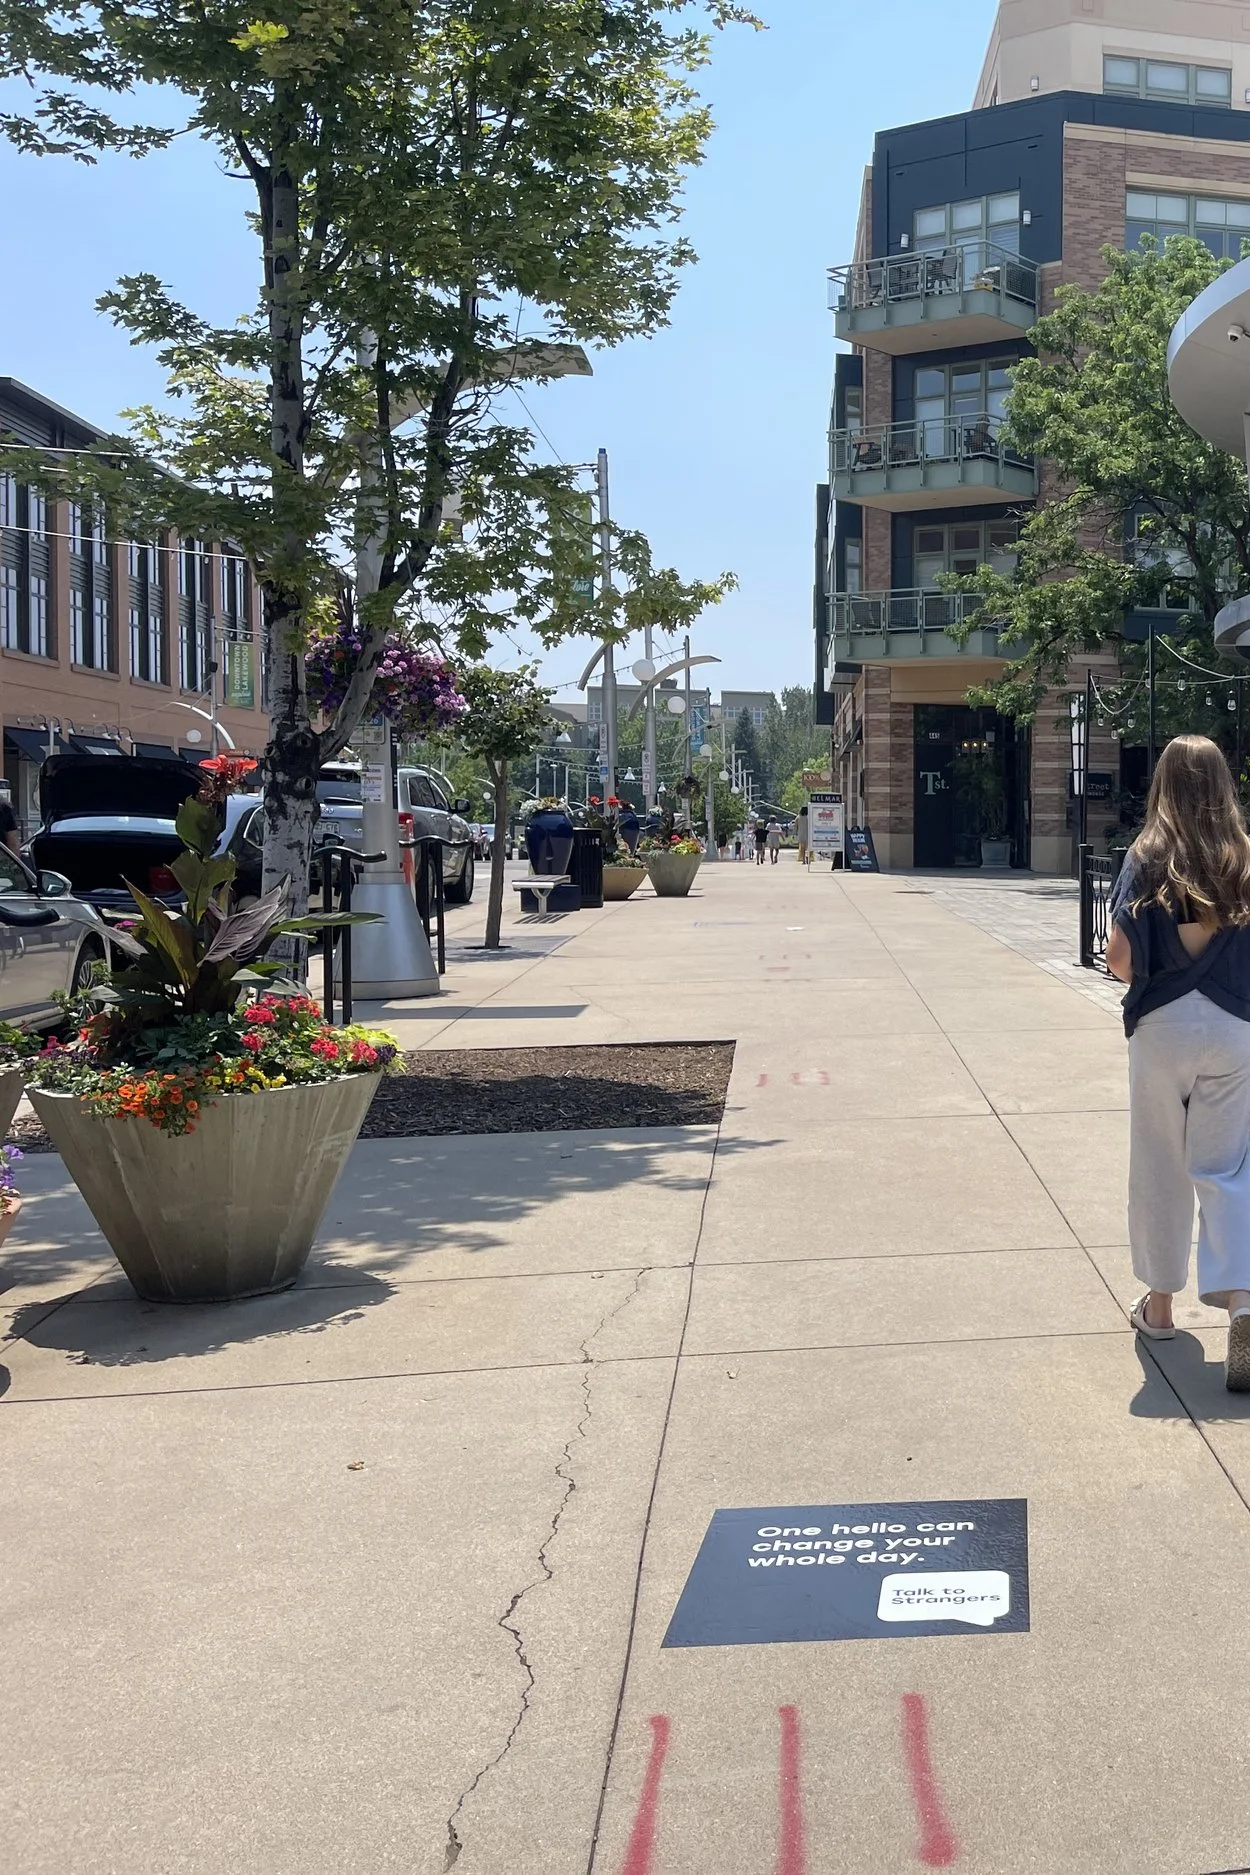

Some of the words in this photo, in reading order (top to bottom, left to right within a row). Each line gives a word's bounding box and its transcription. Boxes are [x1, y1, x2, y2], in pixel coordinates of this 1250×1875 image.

[757, 1526, 822, 1538] One
[831, 1522, 907, 1535] hello
[916, 1521, 975, 1532] can
[752, 1538, 874, 1552] change
[884, 1535, 956, 1551] your
[747, 1553, 846, 1567] whole
[856, 1551, 925, 1565] day.
[891, 1593, 1001, 1605] Strangers
[892, 1587, 934, 1596] Talk
[941, 1587, 966, 1595] to
